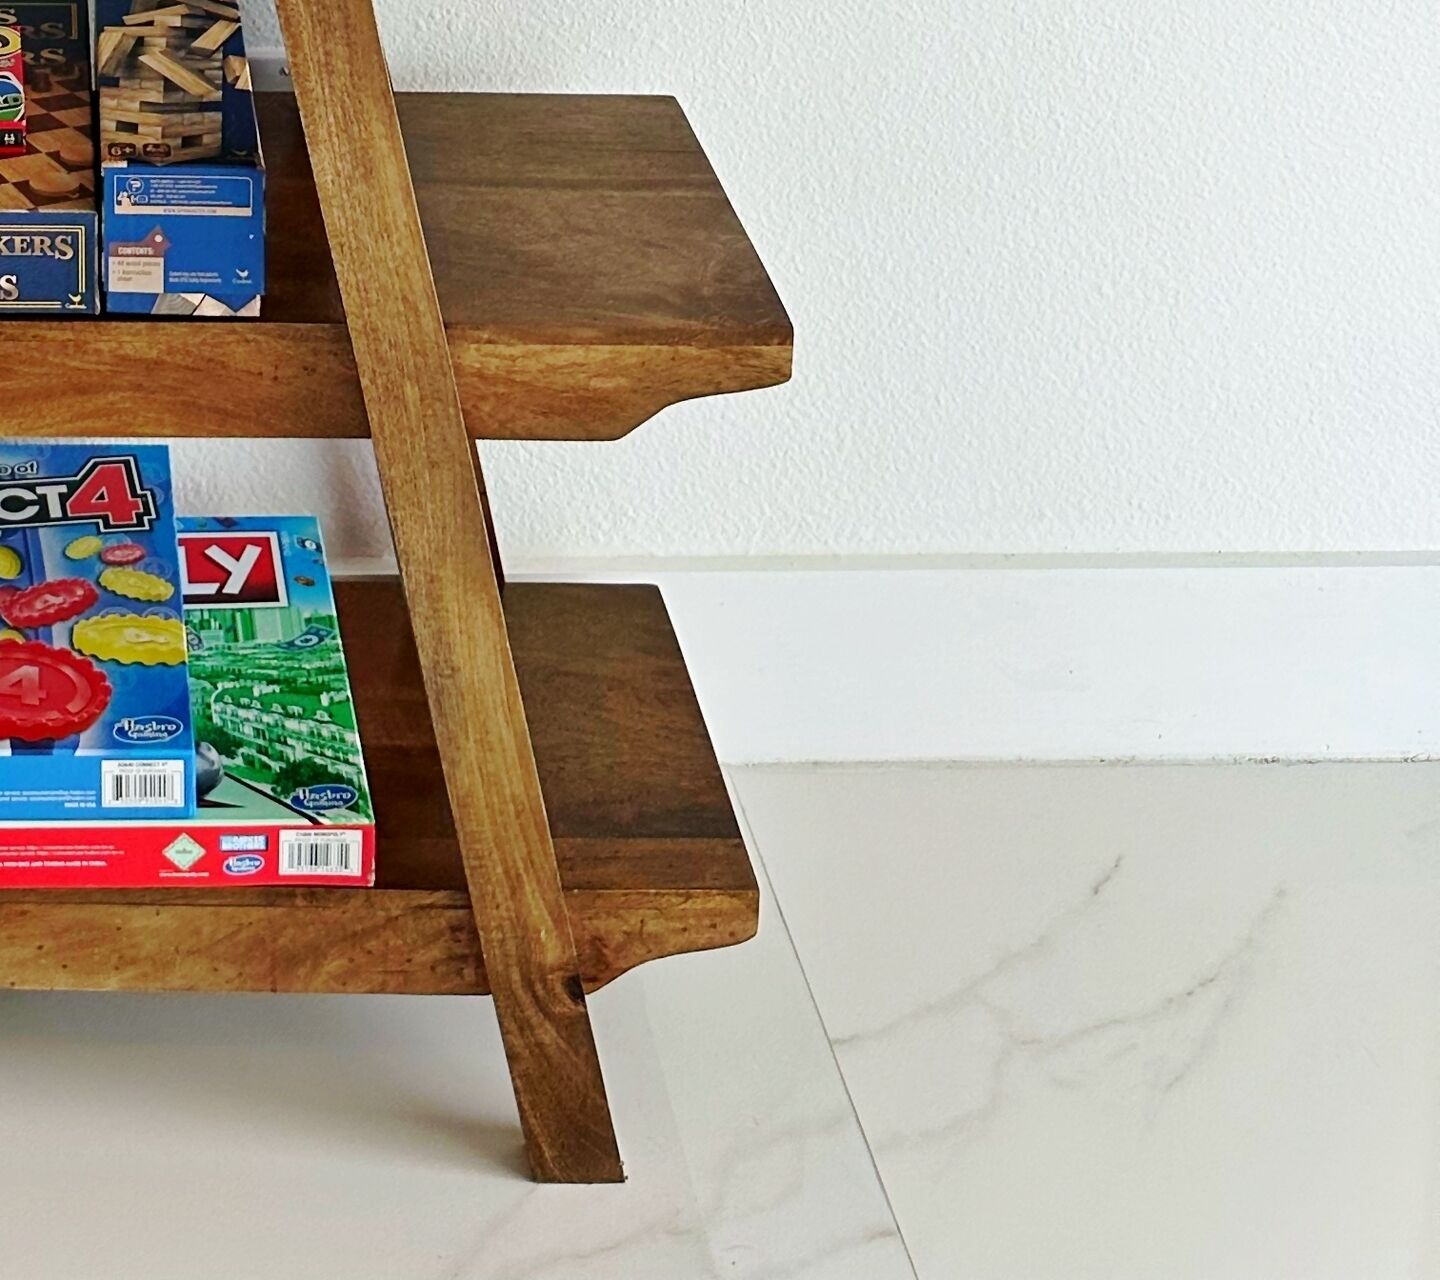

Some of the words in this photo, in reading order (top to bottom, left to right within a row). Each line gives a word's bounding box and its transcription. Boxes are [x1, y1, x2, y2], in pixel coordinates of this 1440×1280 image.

[111, 146, 135, 156] 6+
[14, 461, 38, 476] of
[115, 718, 177, 732] Hasbro
[292, 787, 352, 801] Hasbro
